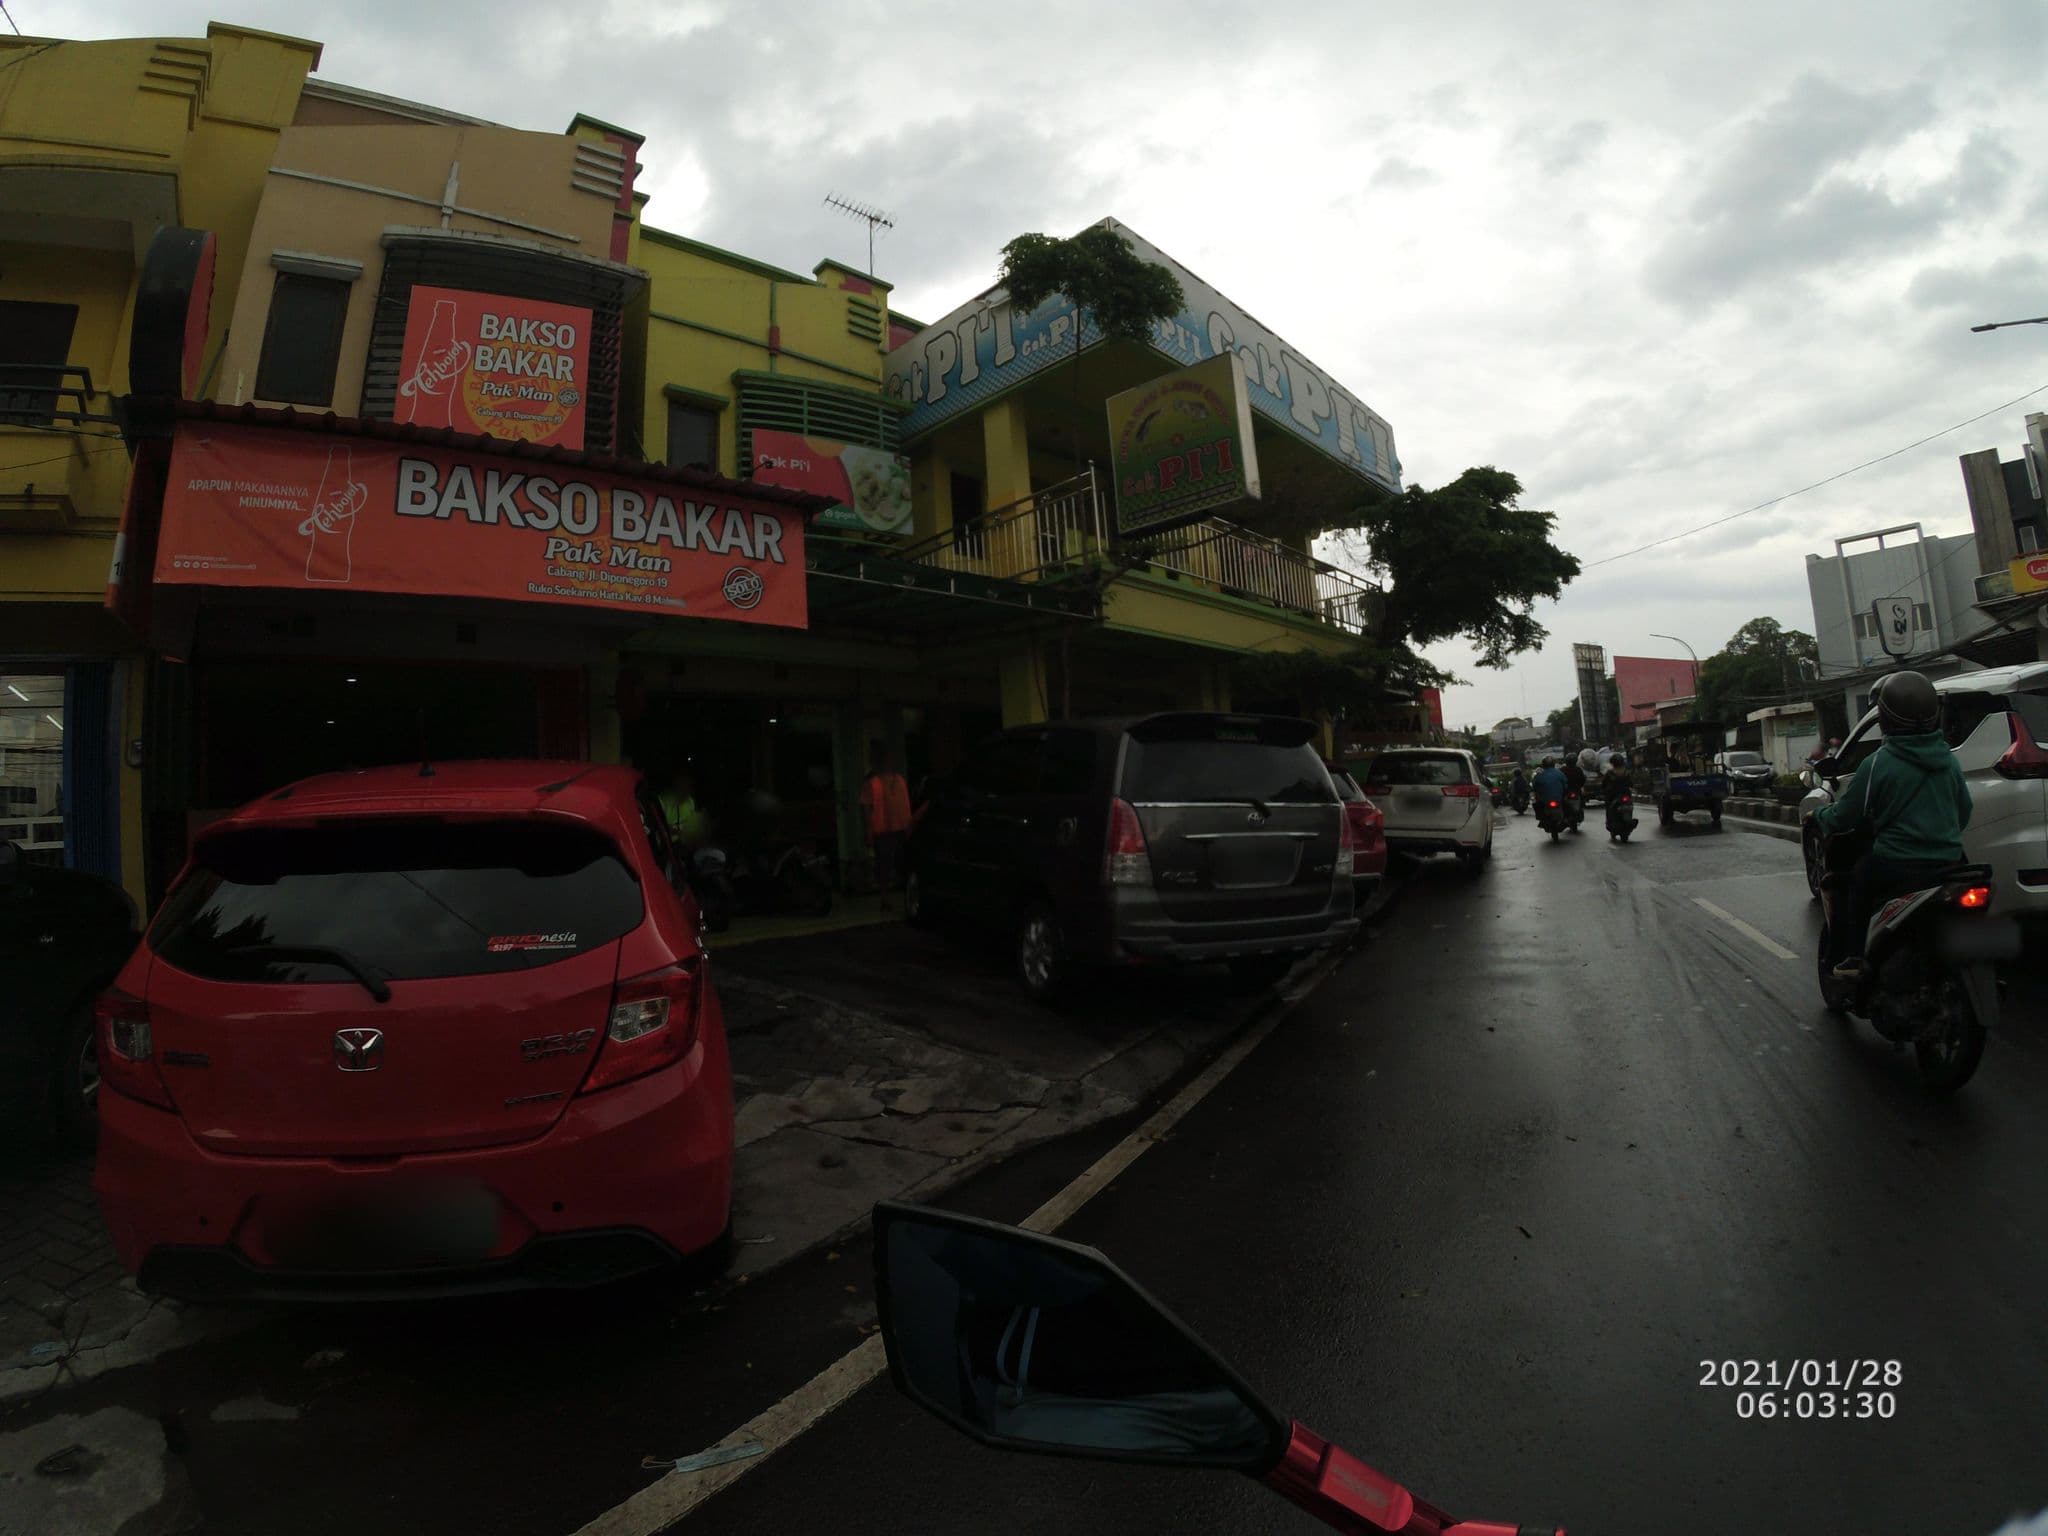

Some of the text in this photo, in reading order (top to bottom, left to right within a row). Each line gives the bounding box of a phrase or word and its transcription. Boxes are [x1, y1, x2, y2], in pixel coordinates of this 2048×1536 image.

[480, 313, 576, 350] BAKSO
[474, 345, 574, 382] BAKAR
[480, 381, 513, 397] Pak
[517, 386, 554, 402] Man
[187, 479, 309, 497] APAPUN MAKANANNYA
[396, 457, 786, 564] BAKSO BAKAR
[544, 536, 672, 574] Pak Man
[547, 565, 586, 582] Cabang
[600, 571, 656, 588] Diponegoro
[657, 577, 668, 588] 19
[726, 578, 760, 598] SOLO
[528, 582, 553, 595] Ruko
[554, 584, 599, 600] Soekarno
[600, 588, 625, 602] Hatta
